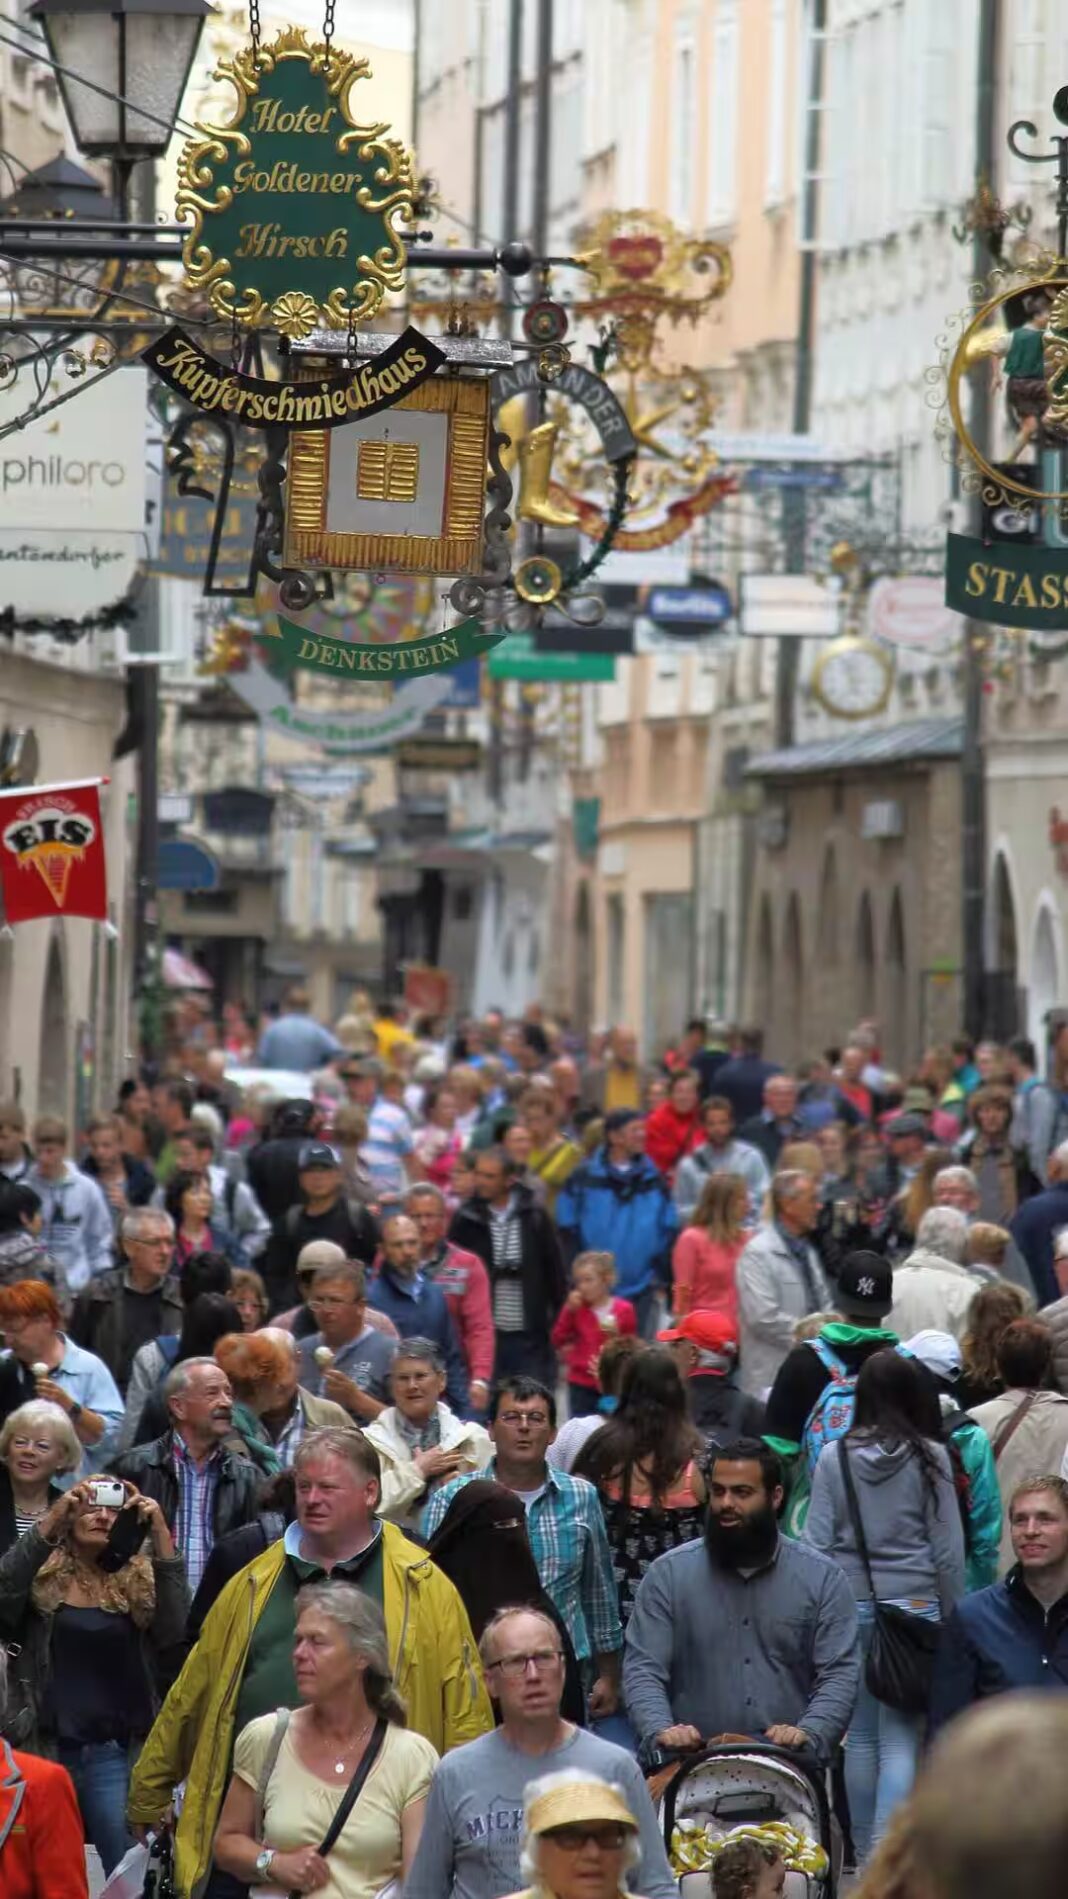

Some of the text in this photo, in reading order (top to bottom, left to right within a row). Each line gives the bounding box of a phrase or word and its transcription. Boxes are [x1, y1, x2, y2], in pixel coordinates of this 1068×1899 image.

[250, 97, 337, 135] Hotel
[232, 161, 364, 194] Goldener
[236, 223, 348, 258] Hirsch
[156, 339, 428, 422] Kupferschmiedhaus
[493, 361, 623, 436] AMNDER
[2, 455, 125, 493] philoro
[297, 639, 460, 672] DENKSTEIN
[8, 819, 92, 852] EIS
